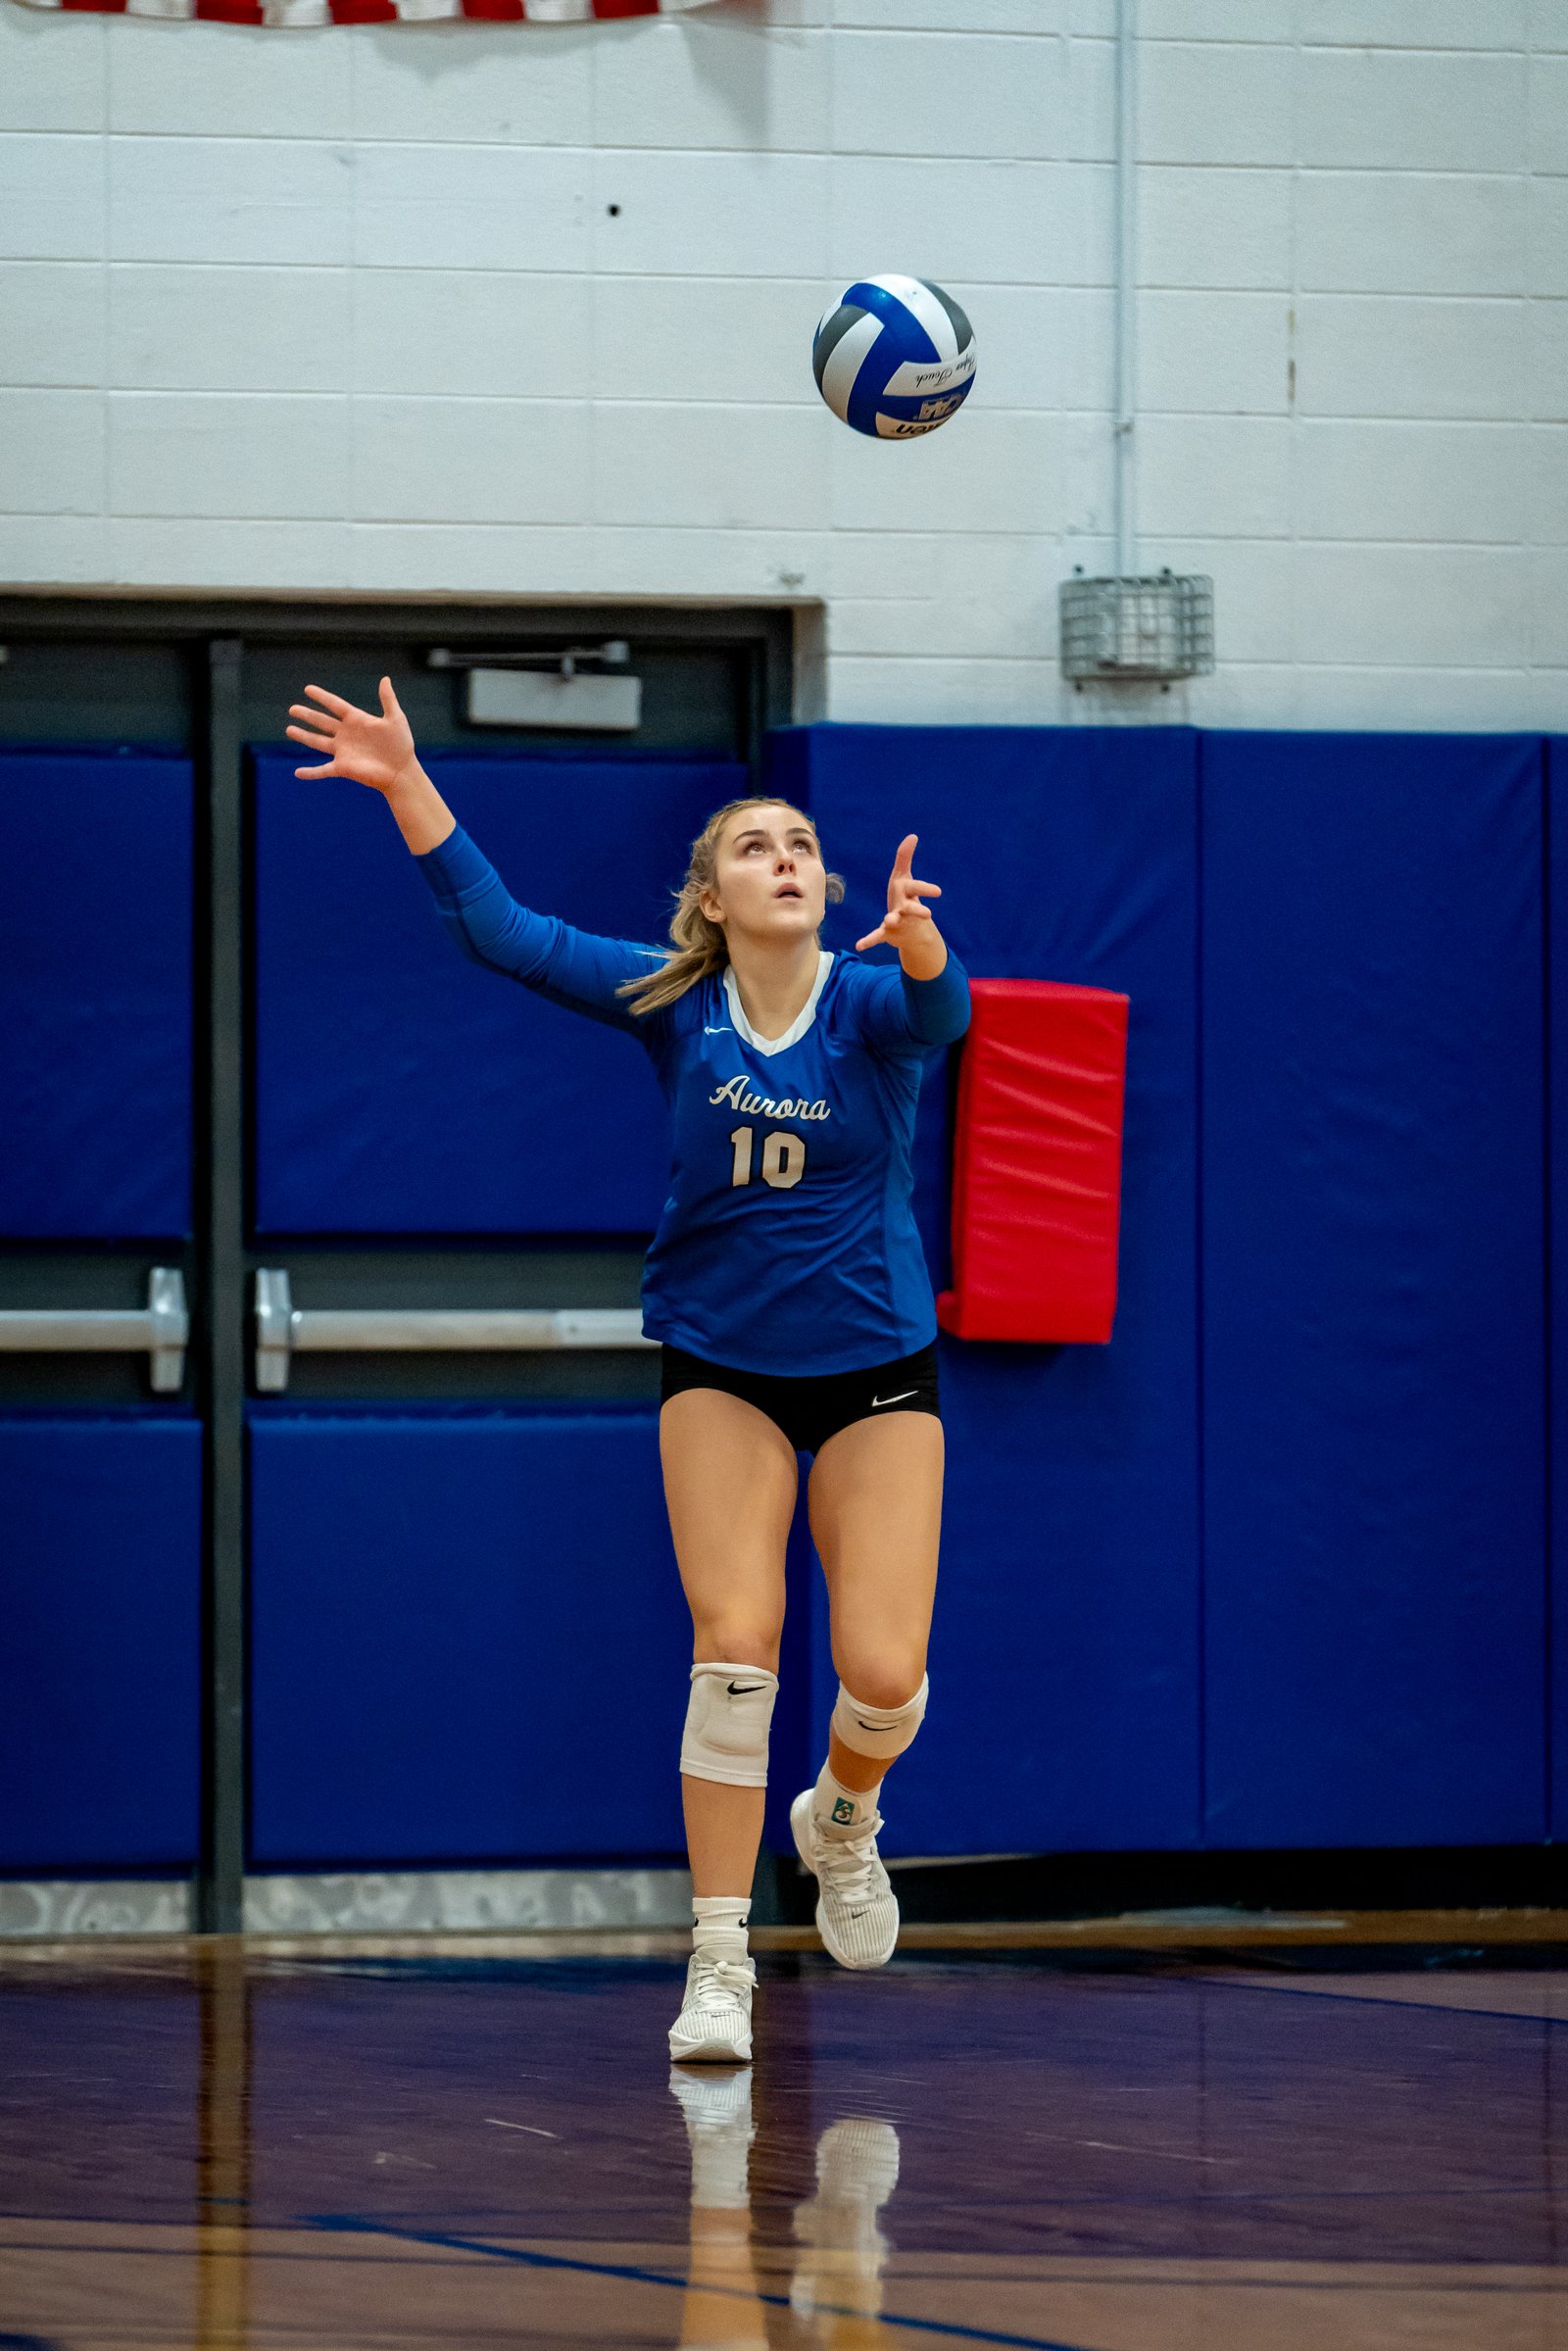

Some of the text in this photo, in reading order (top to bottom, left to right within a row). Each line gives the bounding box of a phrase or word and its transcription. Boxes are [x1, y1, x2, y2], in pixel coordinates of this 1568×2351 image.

[916, 367, 953, 388] Touch
[709, 1075, 831, 1120] Aurora
[730, 1126, 806, 1189] 10
